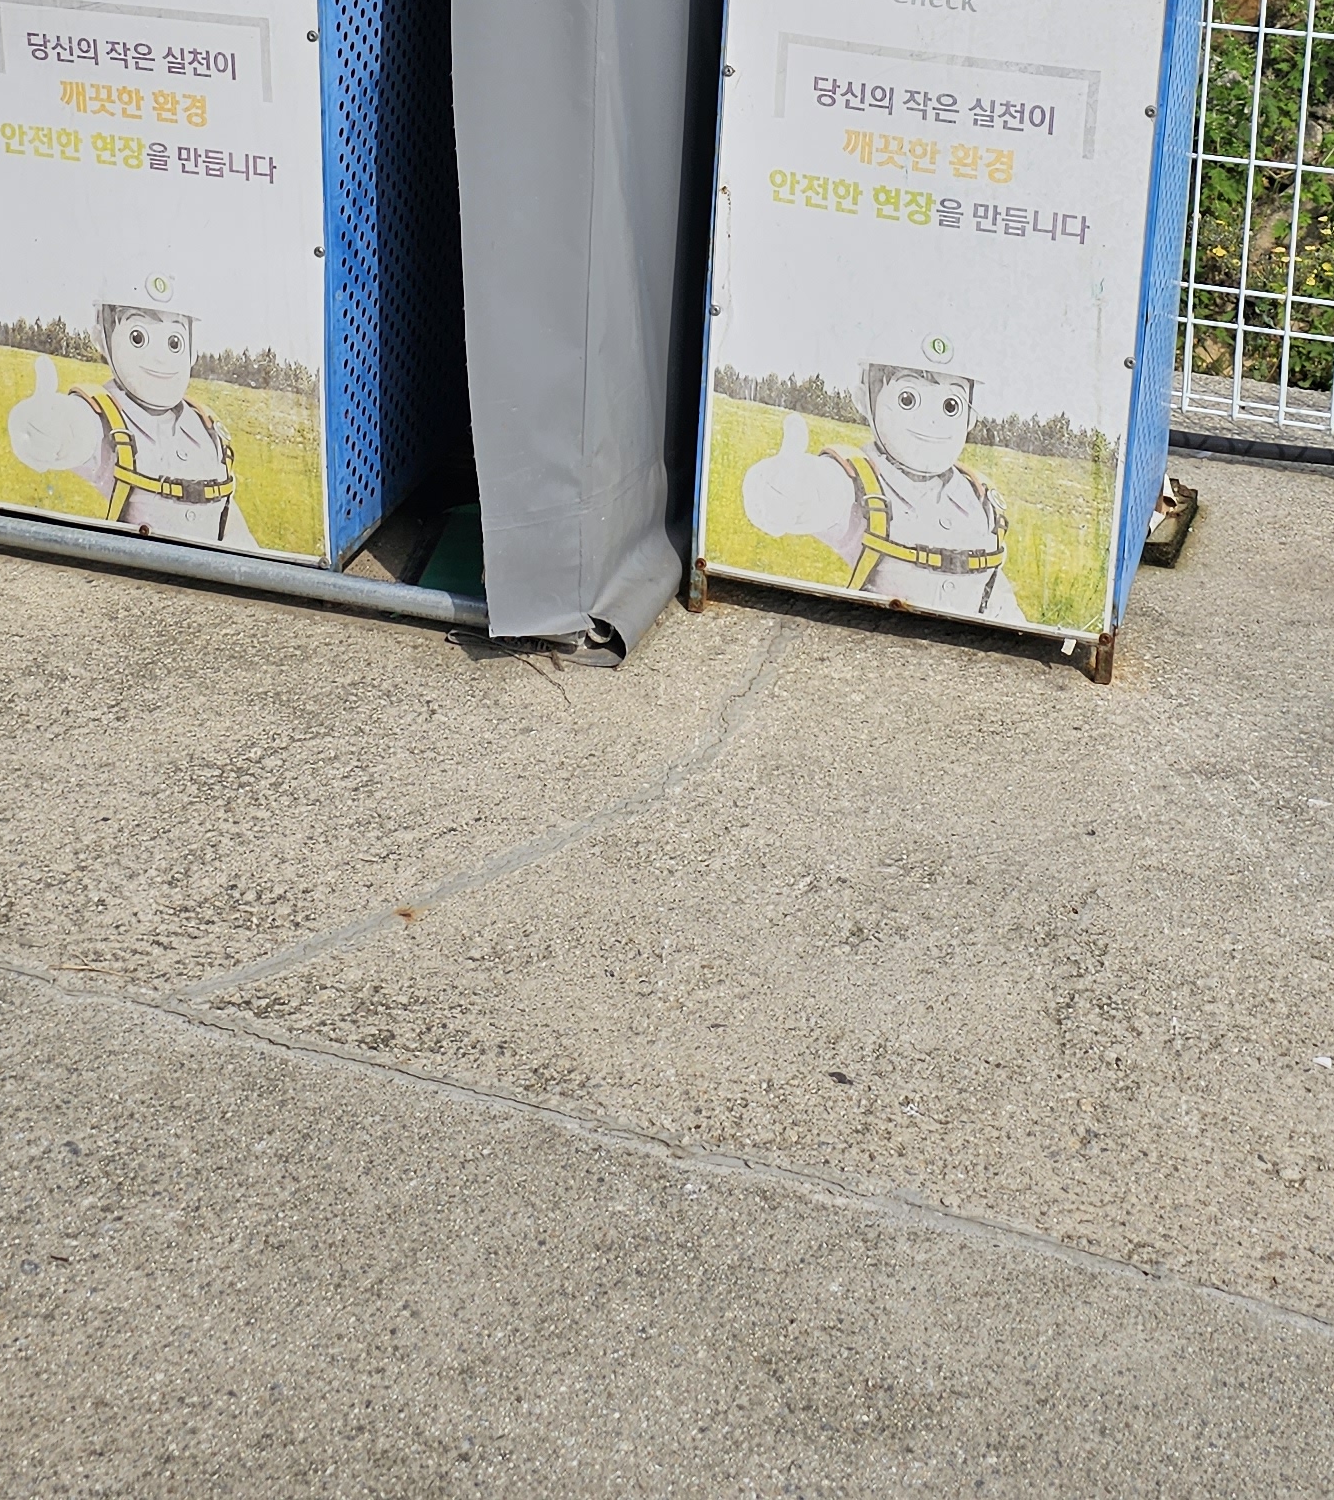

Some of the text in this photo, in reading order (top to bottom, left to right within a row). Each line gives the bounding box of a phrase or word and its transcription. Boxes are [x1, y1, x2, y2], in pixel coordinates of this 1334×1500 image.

[26, 32, 237, 80] 당신의 작은 실천이
[59, 80, 208, 128] 깨끗한 환경
[813, 75, 1056, 135] 당신의 작은 실천이
[0, 122, 277, 184] 안전한 현장을 만듭니다
[842, 128, 1015, 185] 깨끗한 환경
[768, 169, 1090, 245] 안전한 현장을 만듭니다
